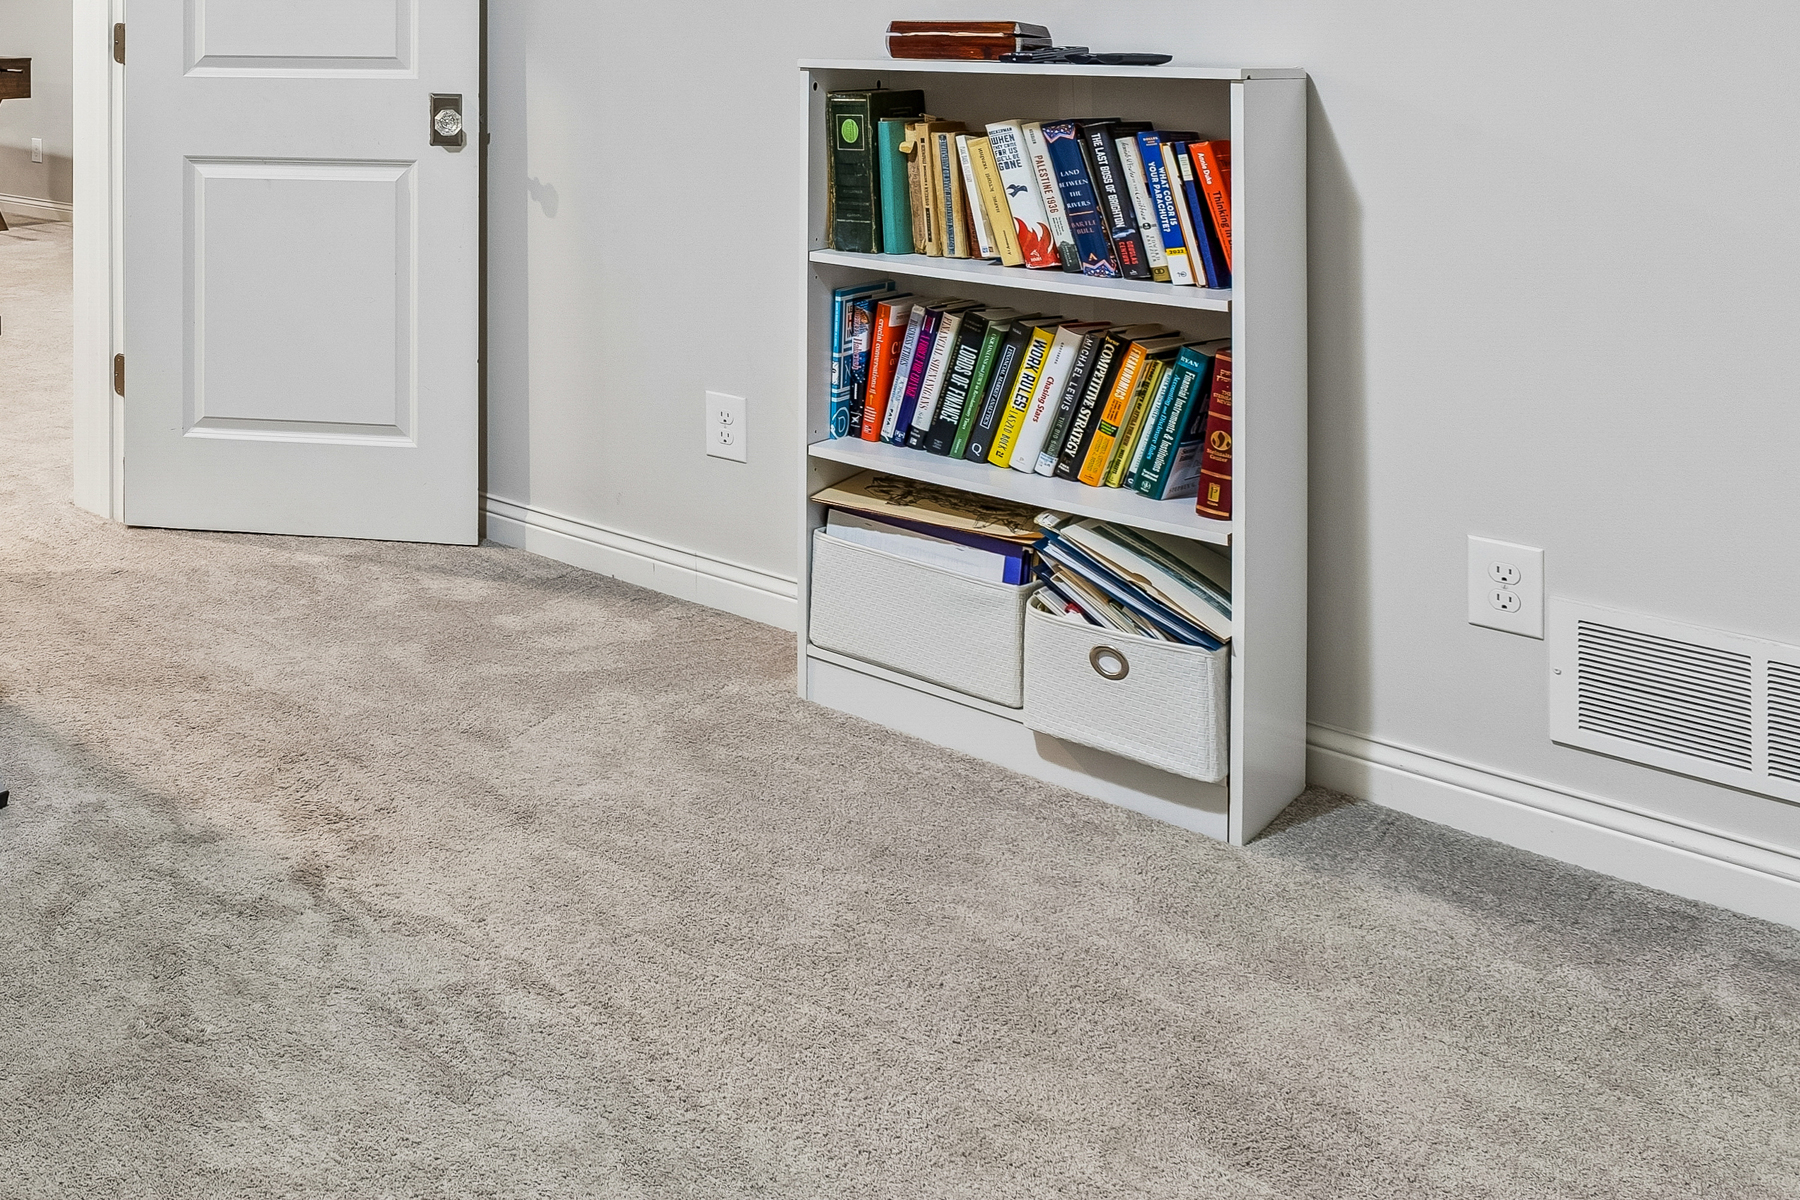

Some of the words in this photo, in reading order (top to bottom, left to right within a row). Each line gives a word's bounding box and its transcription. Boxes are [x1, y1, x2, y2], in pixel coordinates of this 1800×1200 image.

[991, 134, 1015, 145] WHEN
[995, 149, 1007, 157] FOR
[1008, 147, 1018, 155] US
[1091, 133, 1103, 147] THE
[998, 159, 1022, 171] GONE
[1095, 147, 1108, 165] LAST
[1198, 153, 1208, 168] Annie
[1203, 170, 1212, 184] Duke
[1033, 155, 1053, 194] PALESTINE
[1045, 196, 1059, 213] 1936
[1059, 179, 1088, 188] BETWEEN
[1060, 169, 1080, 177] LAND
[1100, 166, 1113, 183] BOSS
[1105, 184, 1116, 193] OF
[1148, 162, 1158, 183] YOUR
[1153, 184, 1170, 232] PARACHUTE?
[1158, 167, 1168, 189] WHAT
[1163, 190, 1175, 216] COLOR
[1066, 200, 1091, 209] RIVERS
[1107, 194, 1126, 228] BRIGHTON
[1212, 193, 1230, 227] Thinking
[905, 319, 918, 346] BUSINESS
[934, 316, 951, 357] FINANCIAL
[870, 343, 881, 388] conversations
[900, 345, 911, 367] ETHICS
[955, 344, 977, 376] LORDS
[1000, 348, 1013, 376] FINANCIAL
[1025, 338, 1048, 373] WORK
[1073, 338, 1093, 379] MICHAEL
[1180, 356, 1199, 368] RYAN
[919, 358, 940, 411] SHENANIGANS
[951, 373, 968, 389] OF
[993, 376, 1004, 397] MARKET
[1083, 342, 1115, 409] COMPETITIVE
[1114, 347, 1141, 400] FREAKONOMICS
[1178, 371, 1196, 399] Financial
[1011, 371, 1037, 413] RULES!
[1038, 375, 1055, 405] Chasing
[1061, 381, 1078, 412] LEWIS
[1165, 374, 1181, 407] Accounting
[940, 387, 965, 425] FINANCE
[983, 397, 997, 426] ANALYTICS
[1033, 404, 1045, 424] Stars
[1165, 397, 1186, 435] Instruments
[1057, 416, 1065, 427] THE
[1064, 406, 1092, 458] STRATEGY
[1152, 414, 1167, 444] Disclosure
[1146, 444, 1156, 460] Rules
[1152, 439, 1171, 473] Institutions
